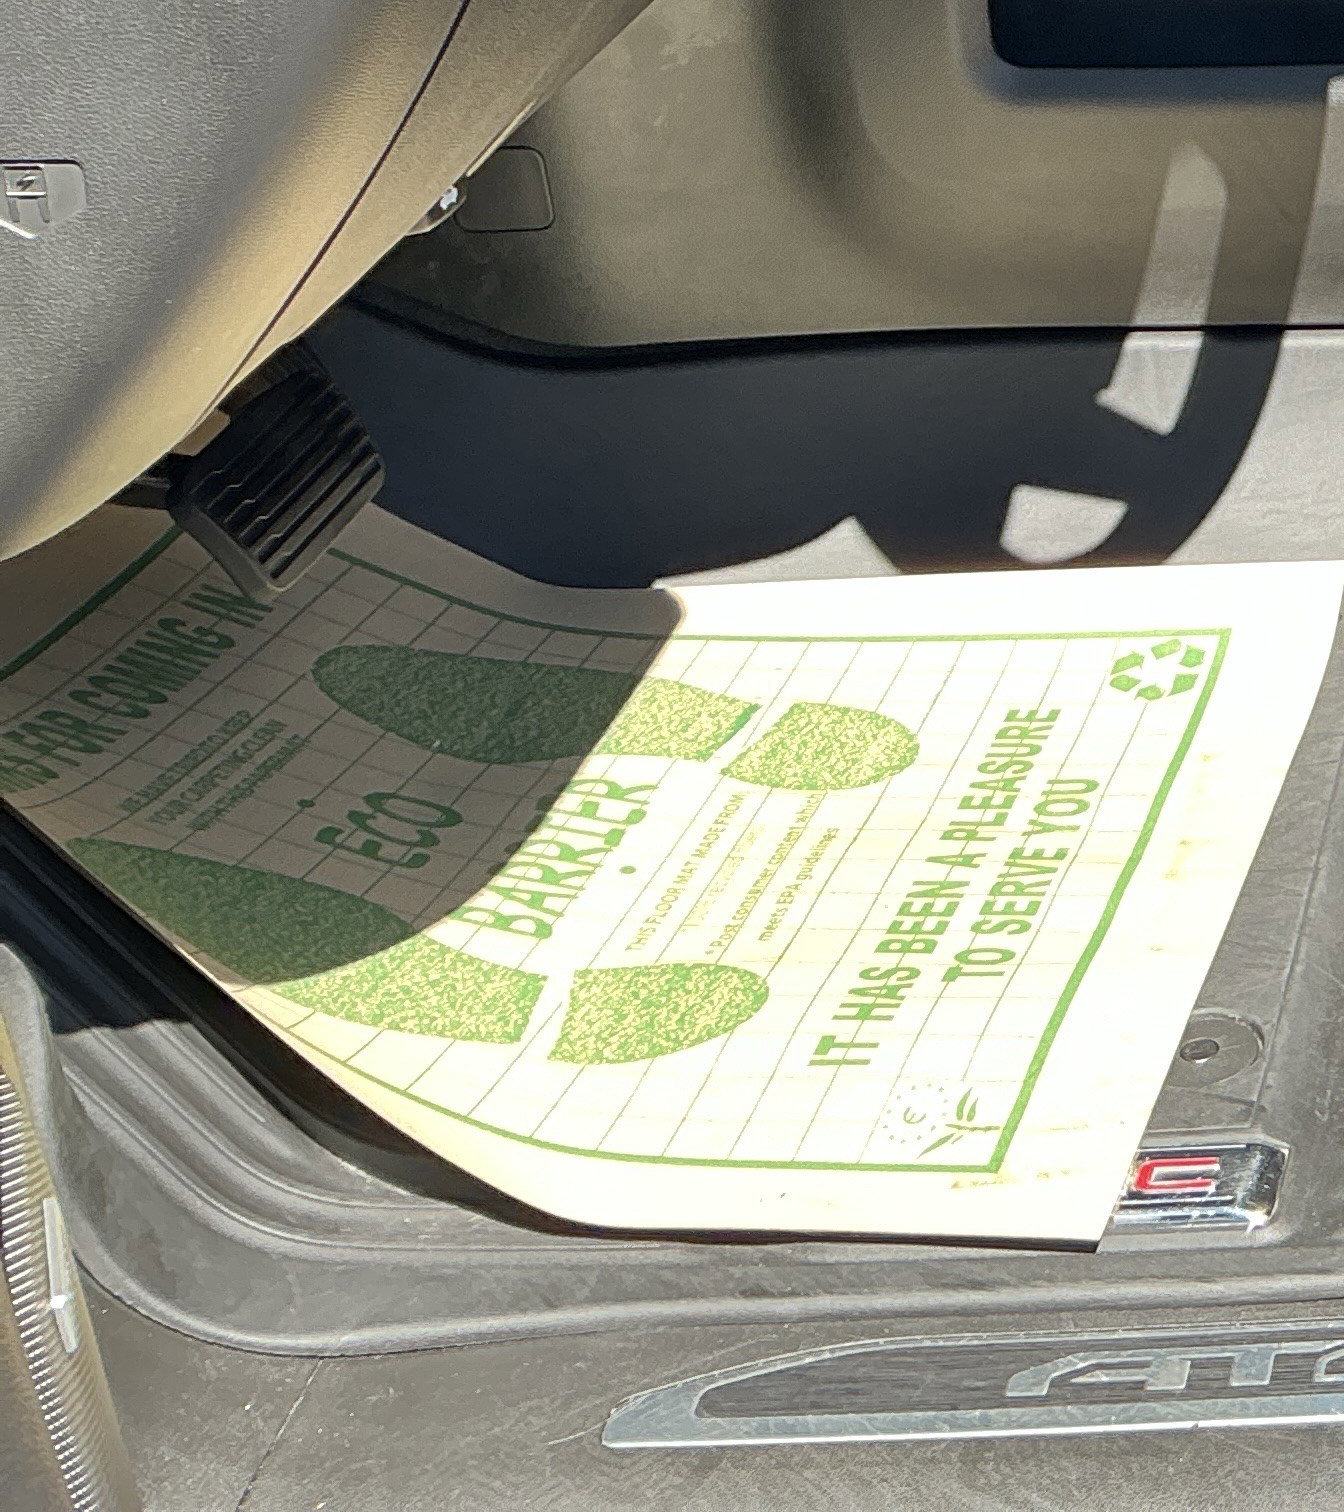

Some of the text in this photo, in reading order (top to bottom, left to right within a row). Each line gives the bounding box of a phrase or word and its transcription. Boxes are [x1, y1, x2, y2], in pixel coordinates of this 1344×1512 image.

[2, 583, 273, 767] FOR COMING IN
[314, 791, 463, 868] ECO
[450, 778, 659, 939] BARRIER
[625, 926, 656, 951] THIS
[643, 887, 685, 925] FLOOR
[673, 861, 699, 884] MAT
[690, 826, 727, 859] MADE
[776, 882, 803, 905] EPA
[796, 826, 840, 882] guidelines
[807, 708, 1062, 1066] IT HAS BEEN A PLEASURE
[941, 778, 1100, 983] TO SERVE YOU
